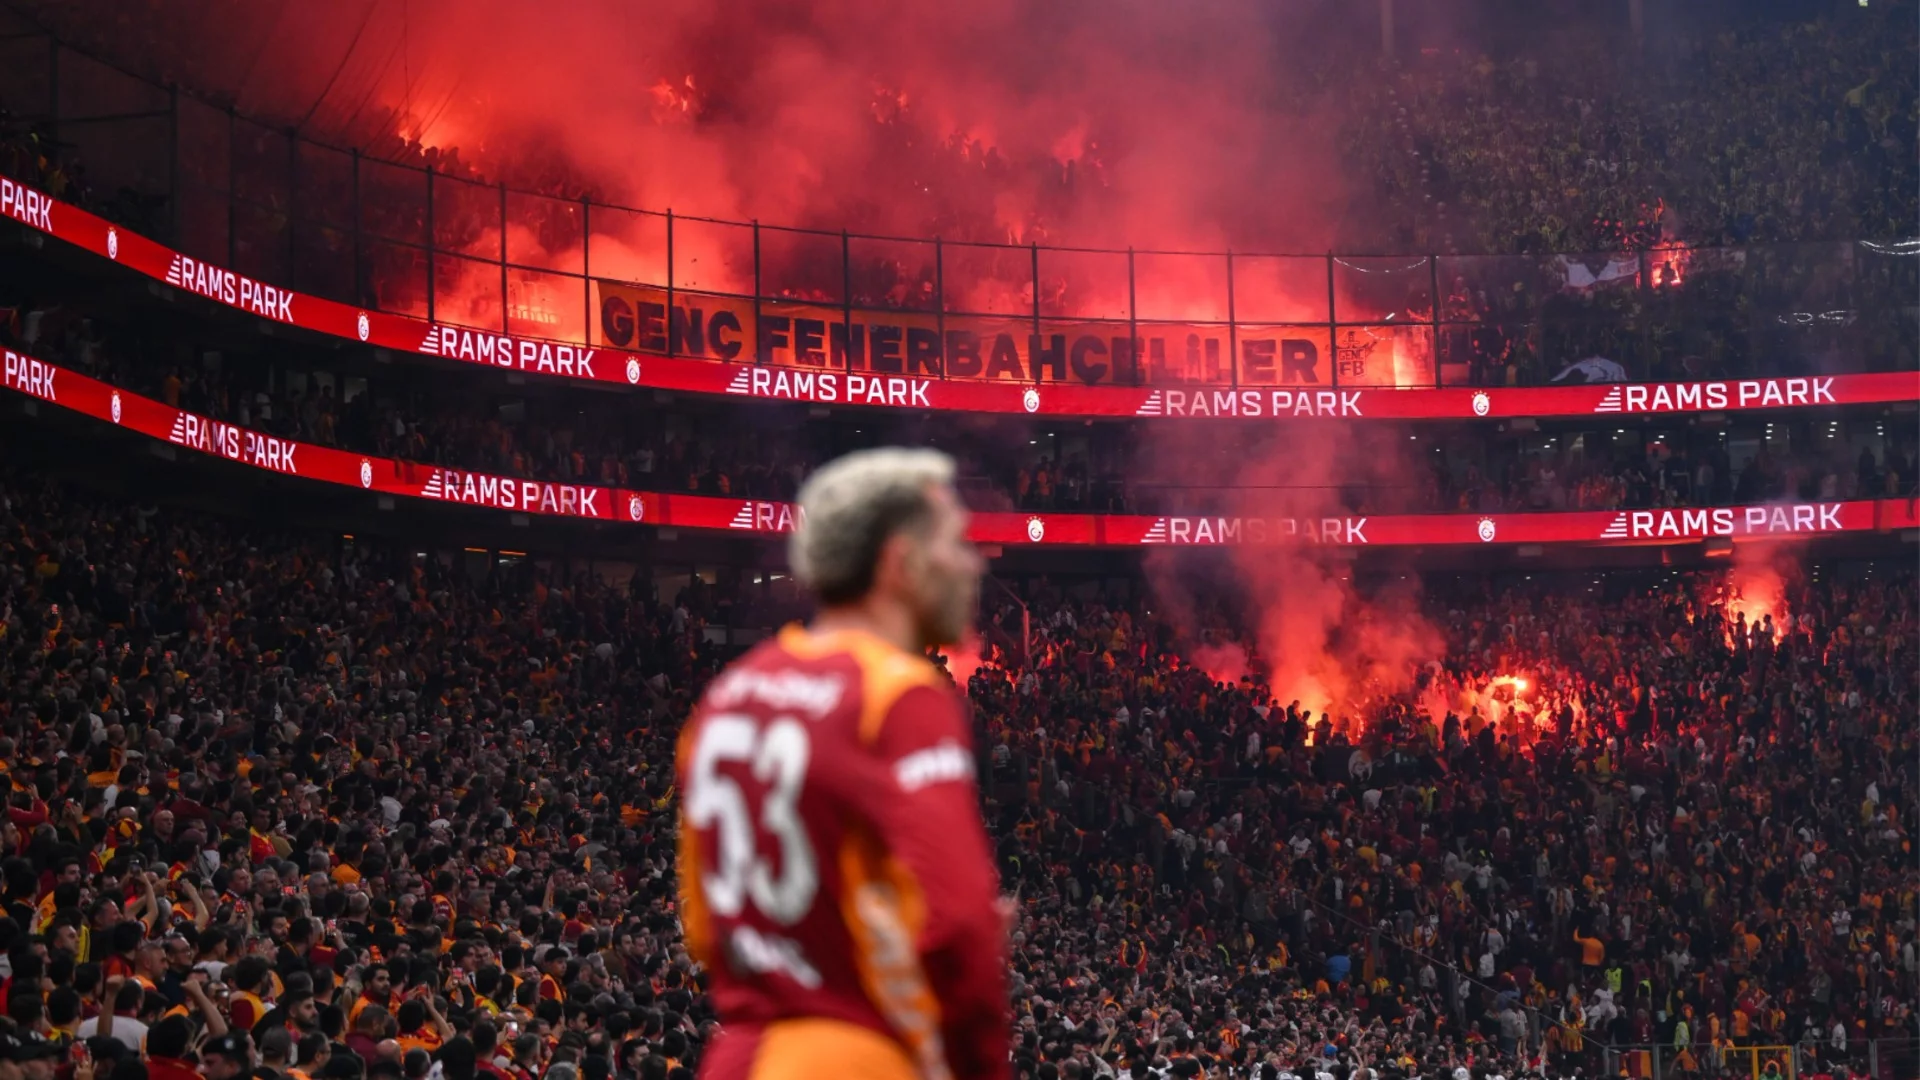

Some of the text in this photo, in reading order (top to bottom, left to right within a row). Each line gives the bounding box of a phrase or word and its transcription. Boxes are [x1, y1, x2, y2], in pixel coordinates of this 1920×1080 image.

[1, 179, 53, 232] PARK
[182, 256, 294, 323] RAMS PARK
[5, 351, 56, 401] PARK
[441, 324, 597, 378] RAMS PARK
[752, 367, 931, 407] RAMS PARK
[1165, 389, 1362, 417] RAMS PARK
[1626, 376, 1836, 412] RAMS PARK
[185, 413, 296, 473] RAMS PARK
[444, 471, 598, 516] RAMS PARK
[1632, 503, 1843, 538] RAMS PARK
[687, 715, 818, 924] 53
